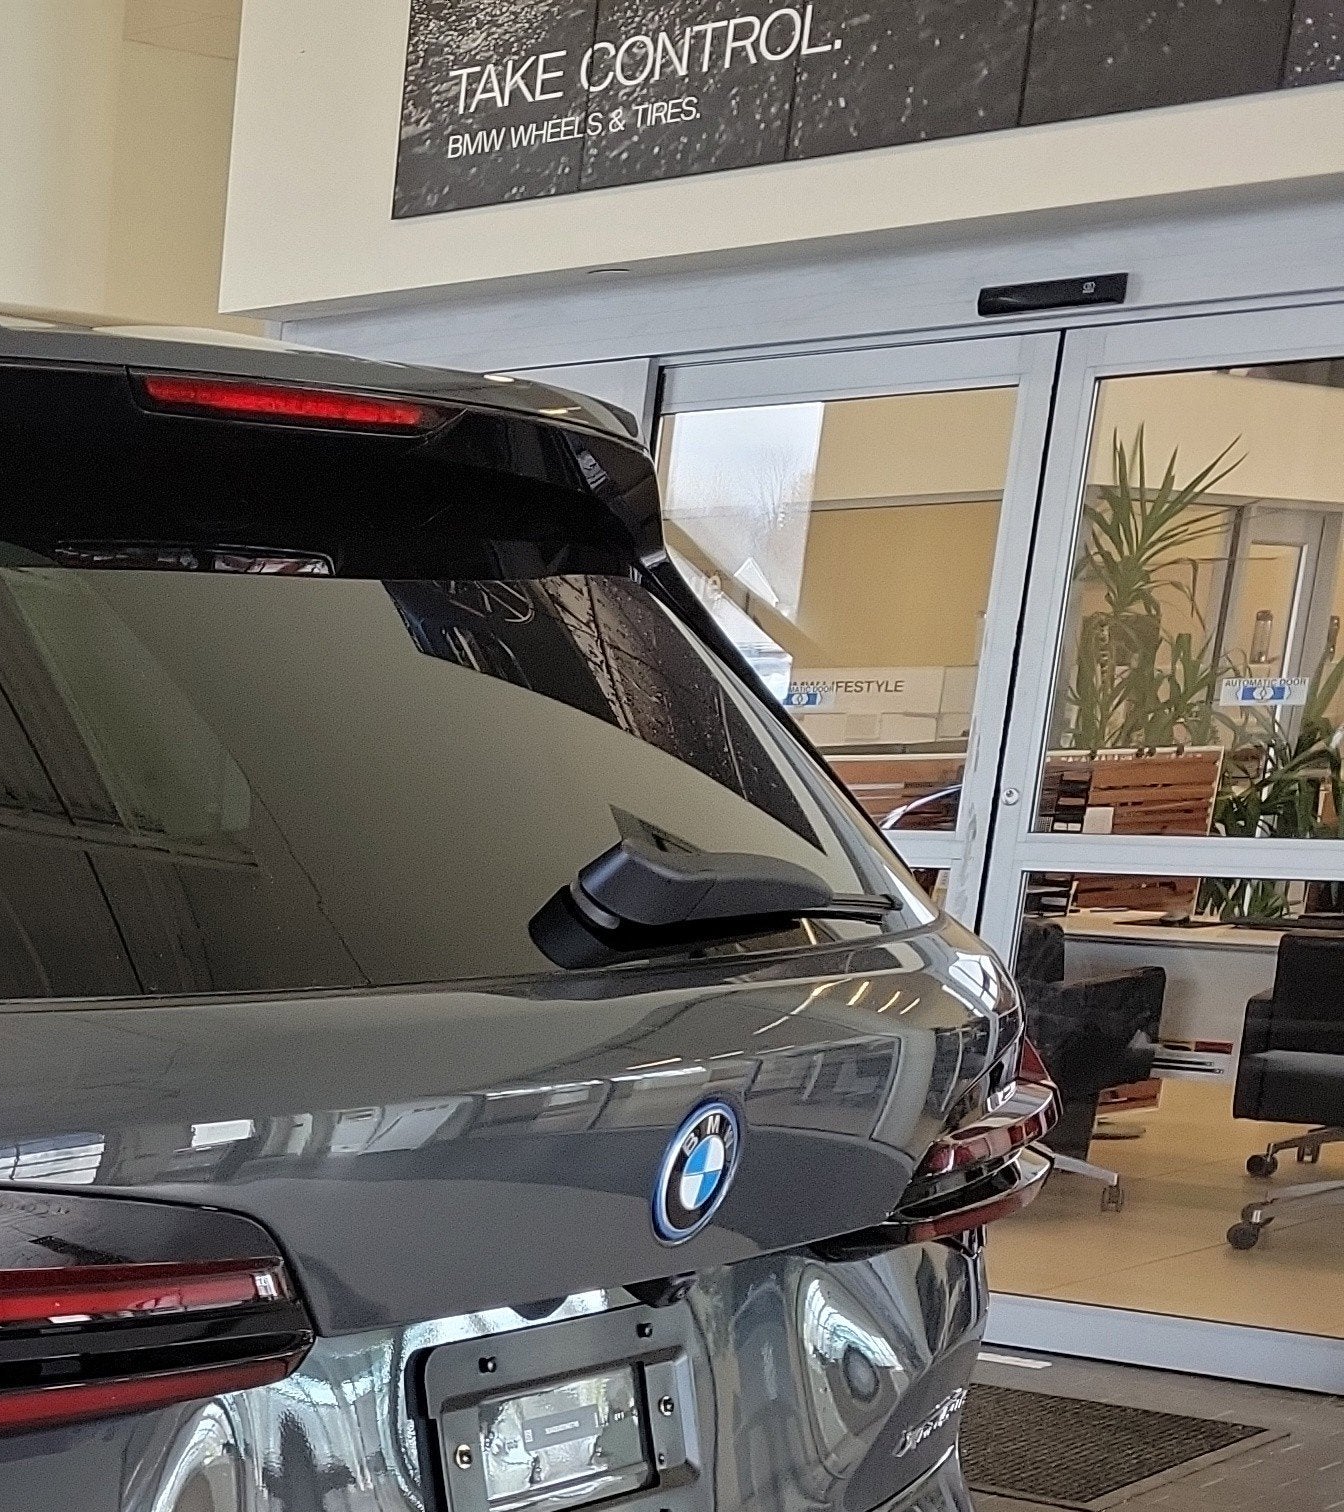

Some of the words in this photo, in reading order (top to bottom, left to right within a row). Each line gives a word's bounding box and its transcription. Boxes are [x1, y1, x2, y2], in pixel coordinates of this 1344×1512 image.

[448, 50, 567, 115] TAKE
[580, 4, 842, 92] CONTROL.
[446, 127, 506, 159] BMW
[511, 112, 604, 149] WHEELS
[608, 108, 626, 133] &
[632, 96, 701, 128] TIRES.
[1279, 678, 1306, 686] DOOR
